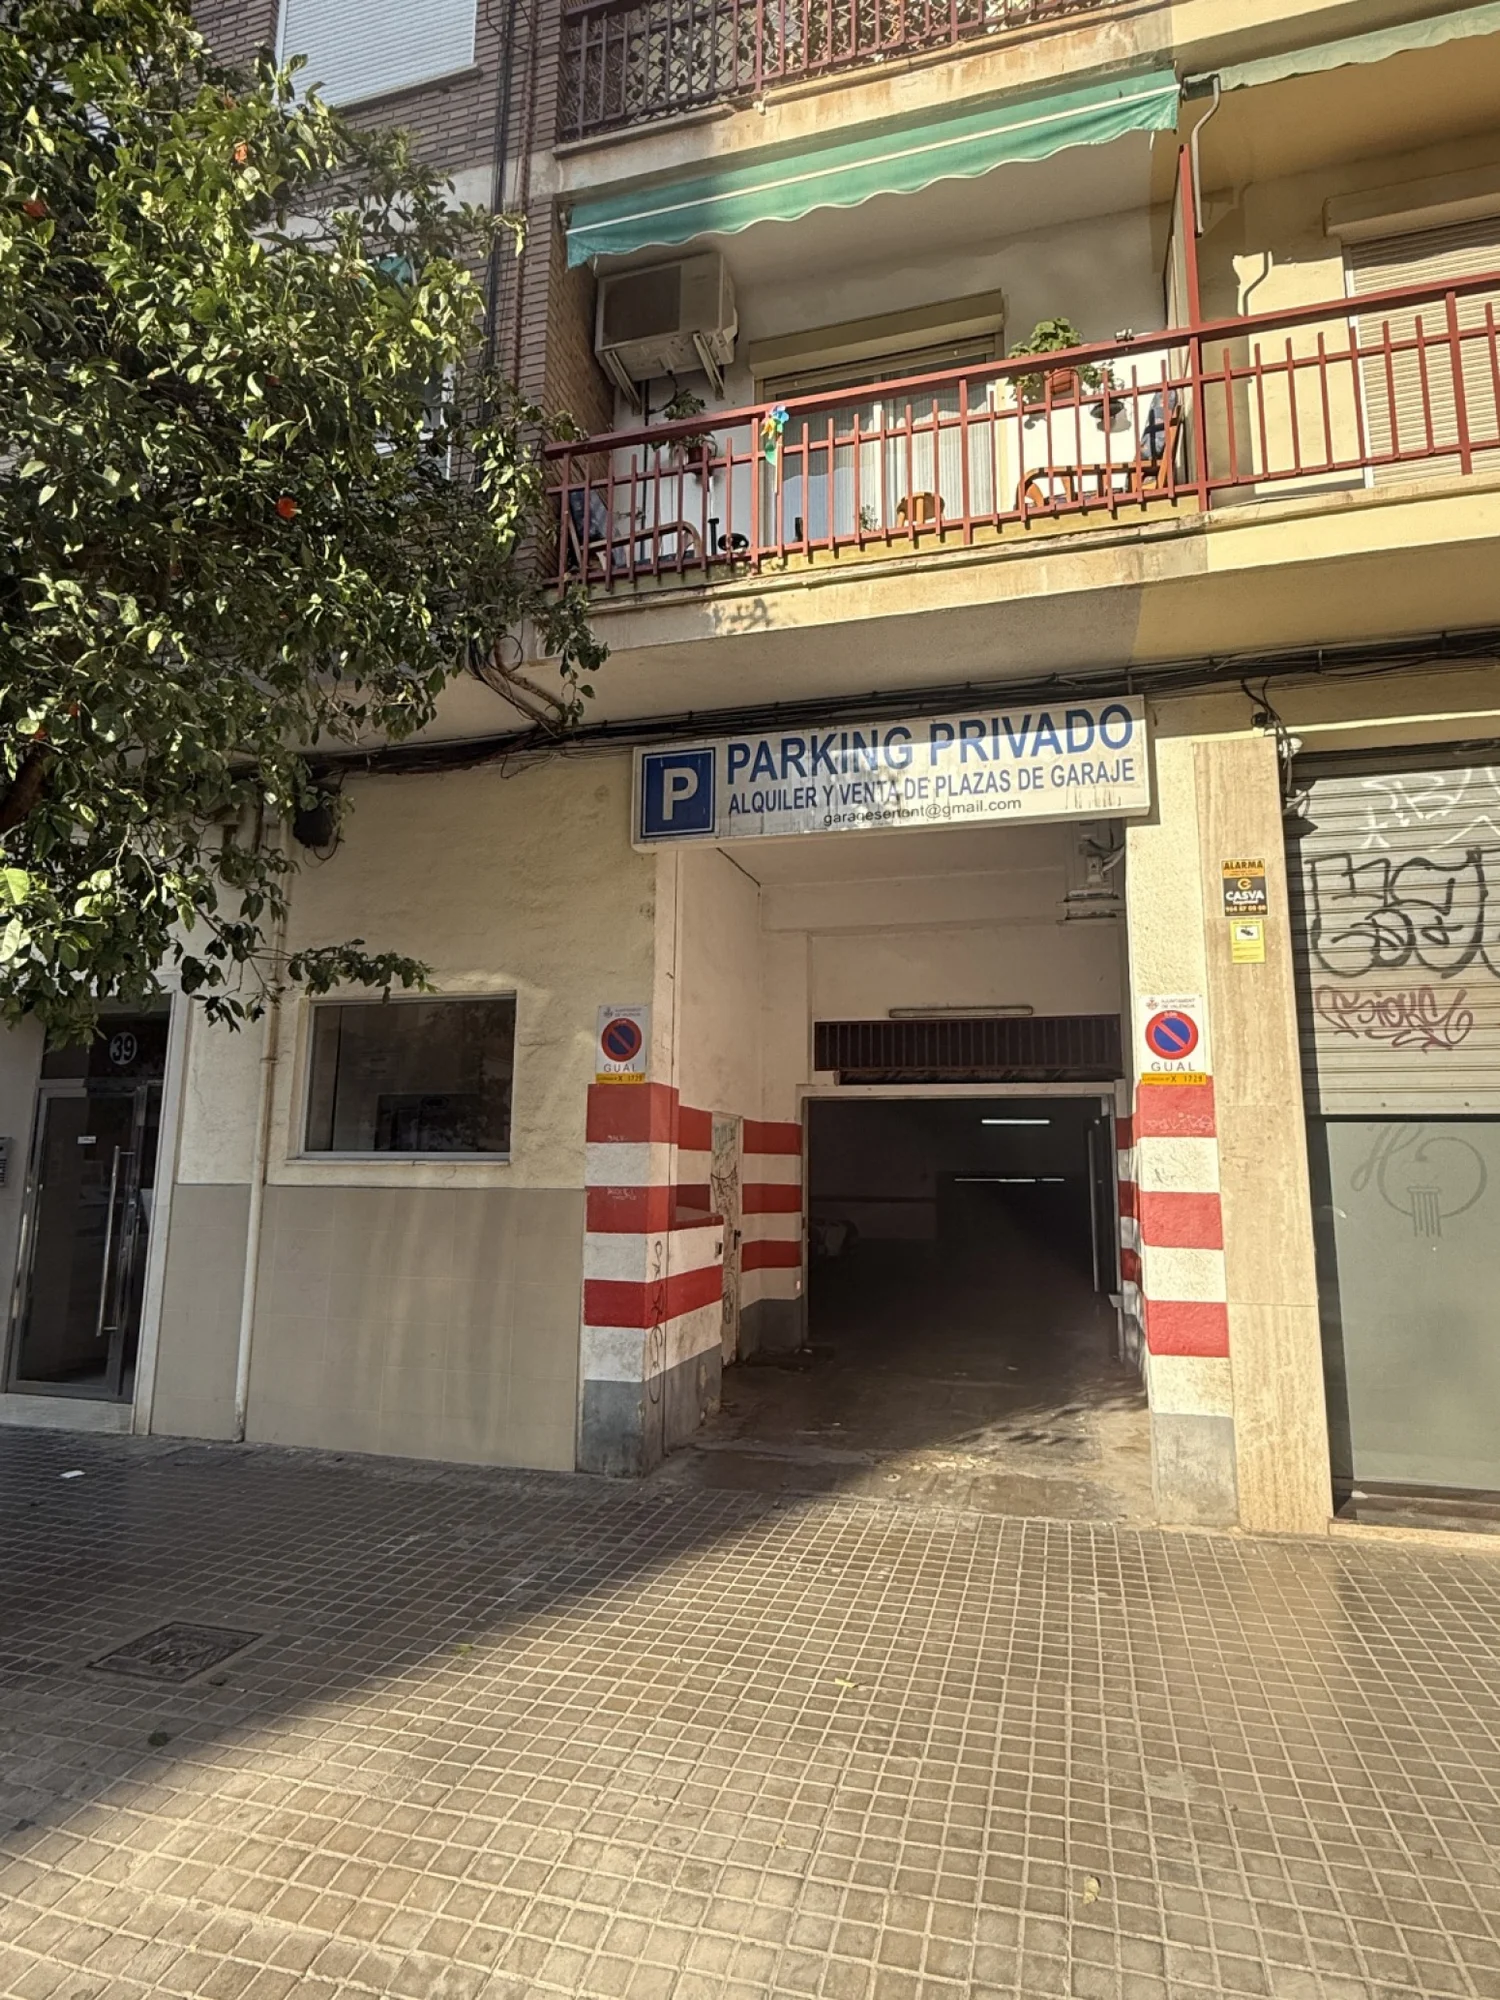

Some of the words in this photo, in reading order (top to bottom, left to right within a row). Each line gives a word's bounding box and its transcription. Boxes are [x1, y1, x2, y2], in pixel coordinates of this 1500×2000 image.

[727, 726, 914, 785] PARKING
[930, 703, 1134, 766] PRIVADO
[662, 766, 699, 821] P
[729, 786, 817, 814] ALQUILER
[823, 784, 835, 806] Y
[839, 778, 904, 805] VENTA
[905, 777, 929, 800] DE
[936, 769, 1011, 798] PLAZAS
[1018, 766, 1045, 790] DE
[1051, 758, 1136, 787] GARAJE
[1224, 861, 1263, 870] ALARMA
[1225, 890, 1264, 901] CASVA
[112, 1035, 135, 1062] 39
[603, 1063, 637, 1073] GUAL
[1151, 1062, 1196, 1072] GUAL
